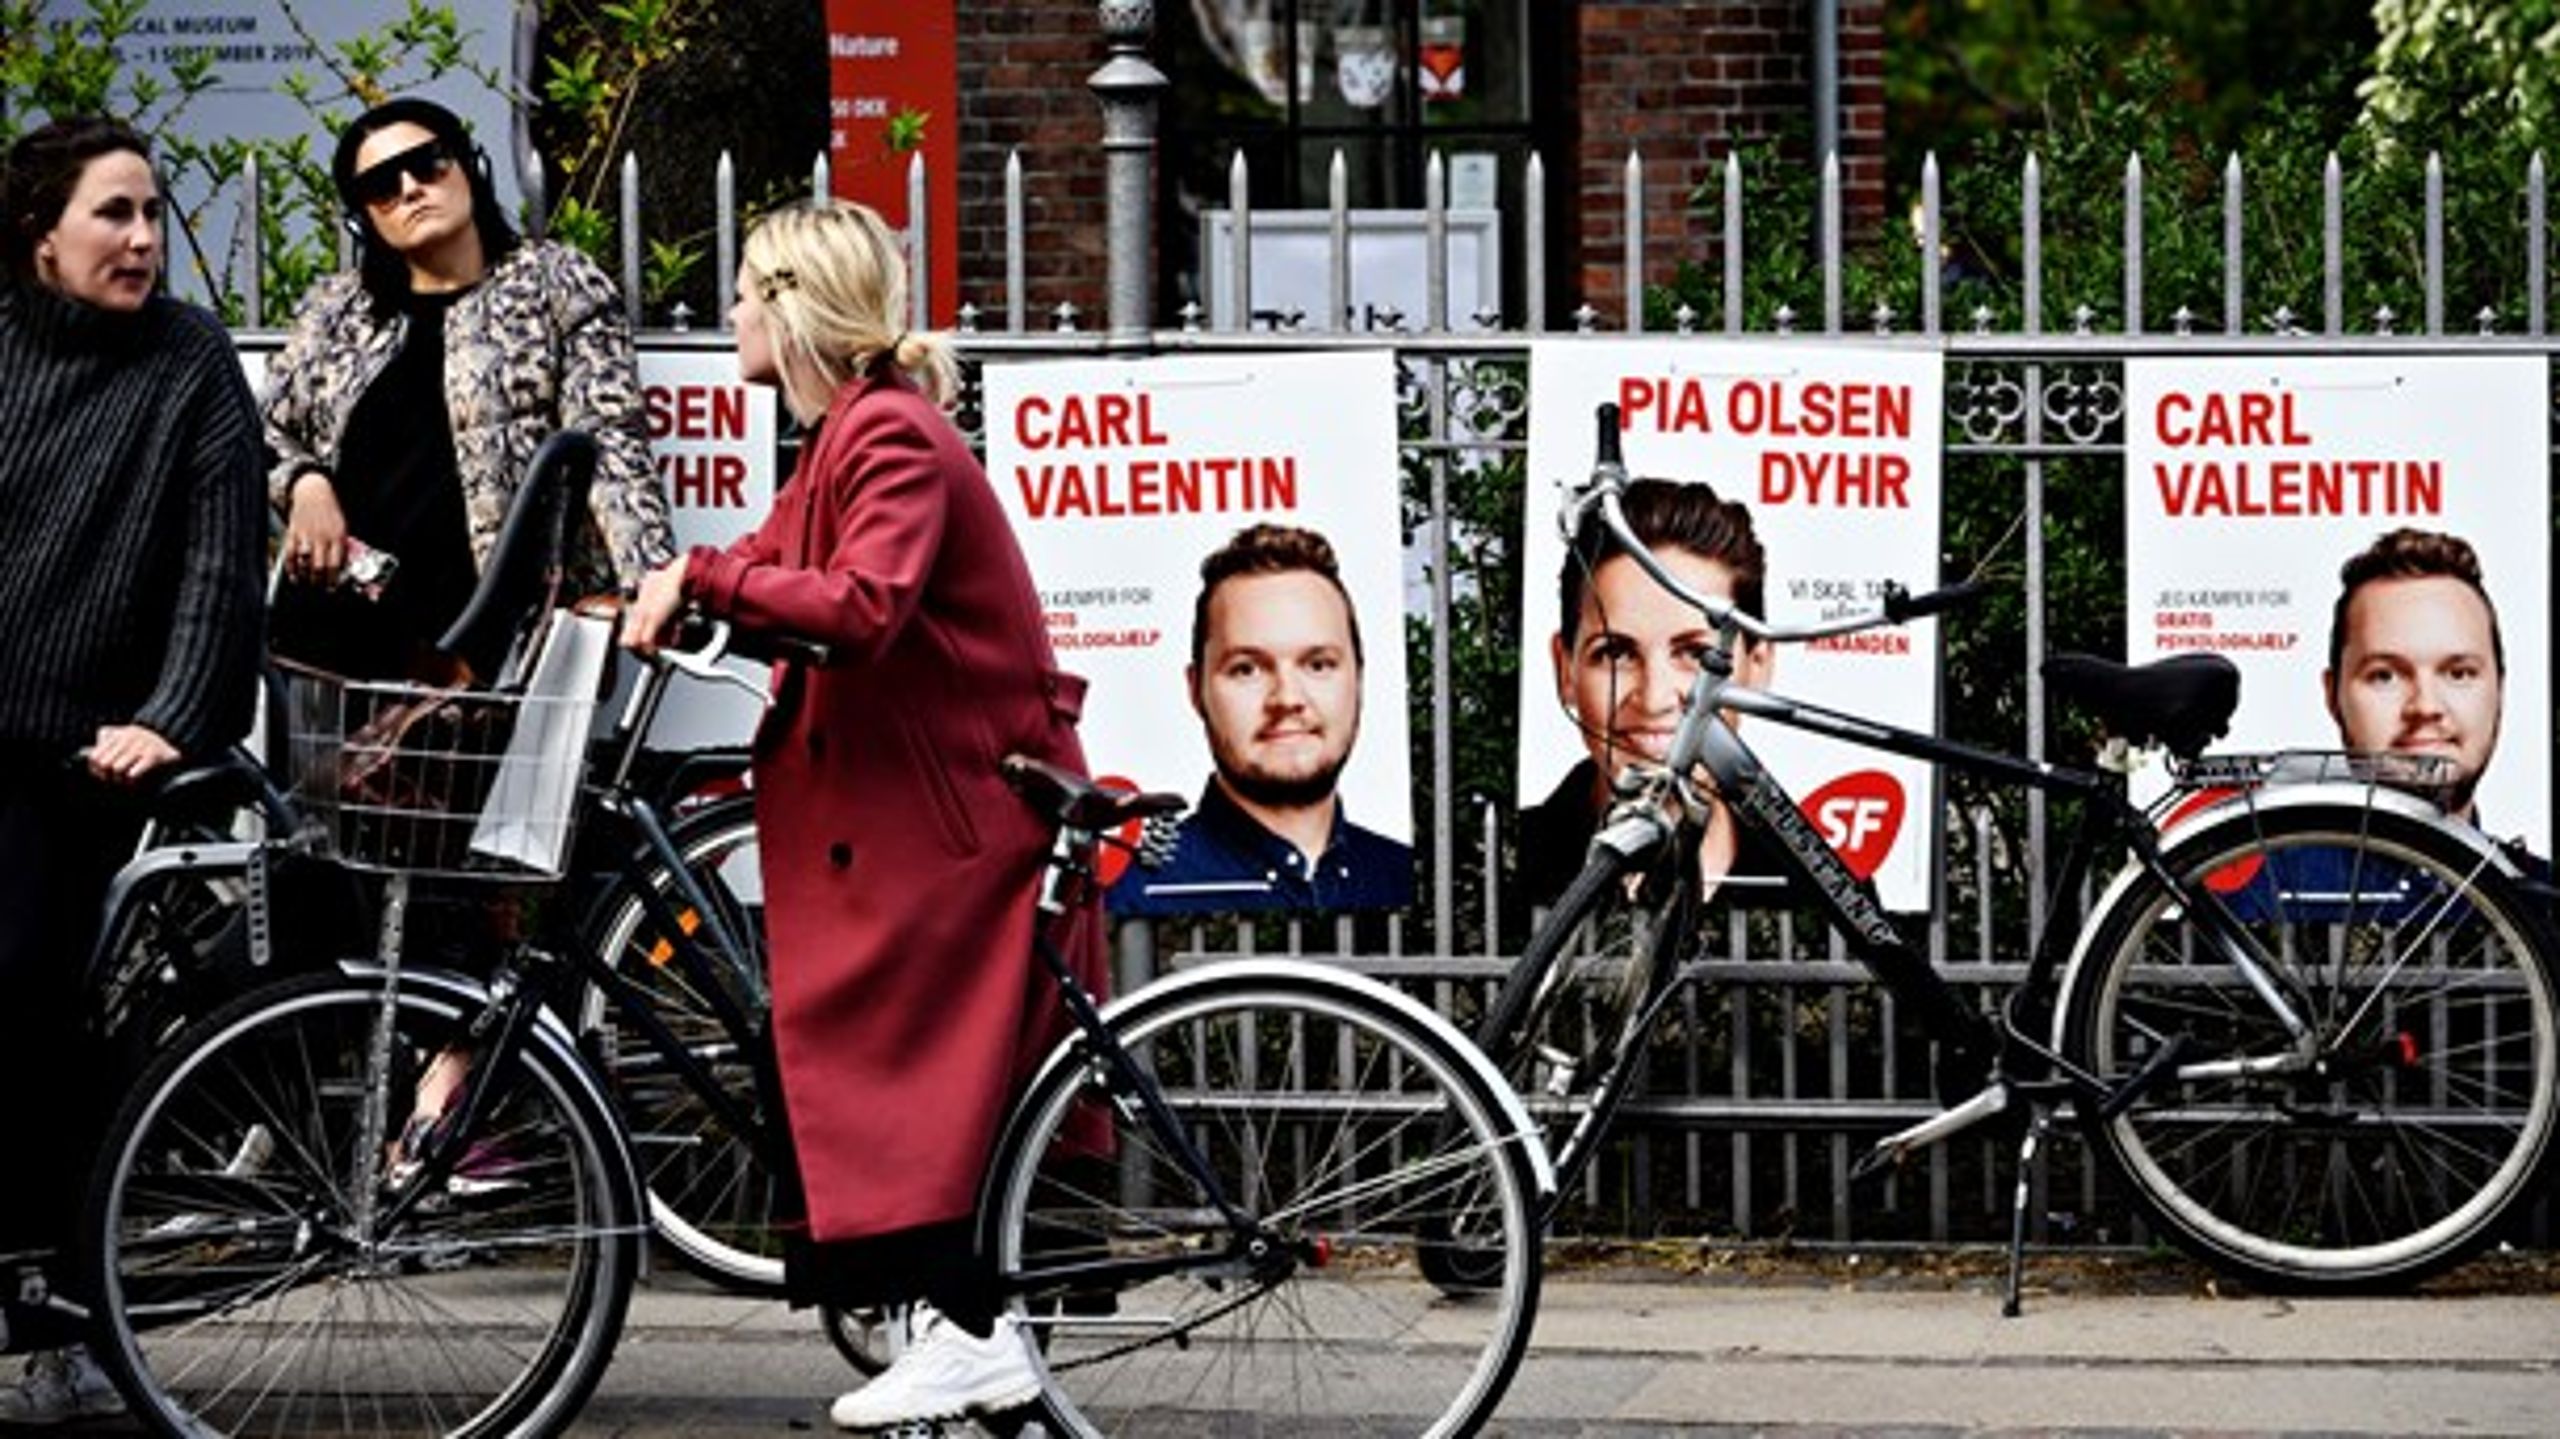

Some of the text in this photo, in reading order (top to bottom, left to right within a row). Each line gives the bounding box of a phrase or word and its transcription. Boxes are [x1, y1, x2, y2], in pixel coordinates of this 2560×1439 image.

[173, 16, 257, 35] MUSEUM
[643, 385, 745, 441] SEN
[1015, 394, 1168, 450] CARL
[1619, 376, 1911, 438] PIA OLSEN
[2155, 392, 2312, 448] CARL
[1015, 457, 1297, 518] VALENTIN
[1759, 451, 1911, 508] DYHR
[2154, 460, 2441, 517] VALENTIN
[2155, 612, 2213, 628] GRATIS
[1818, 797, 1890, 851] SF
